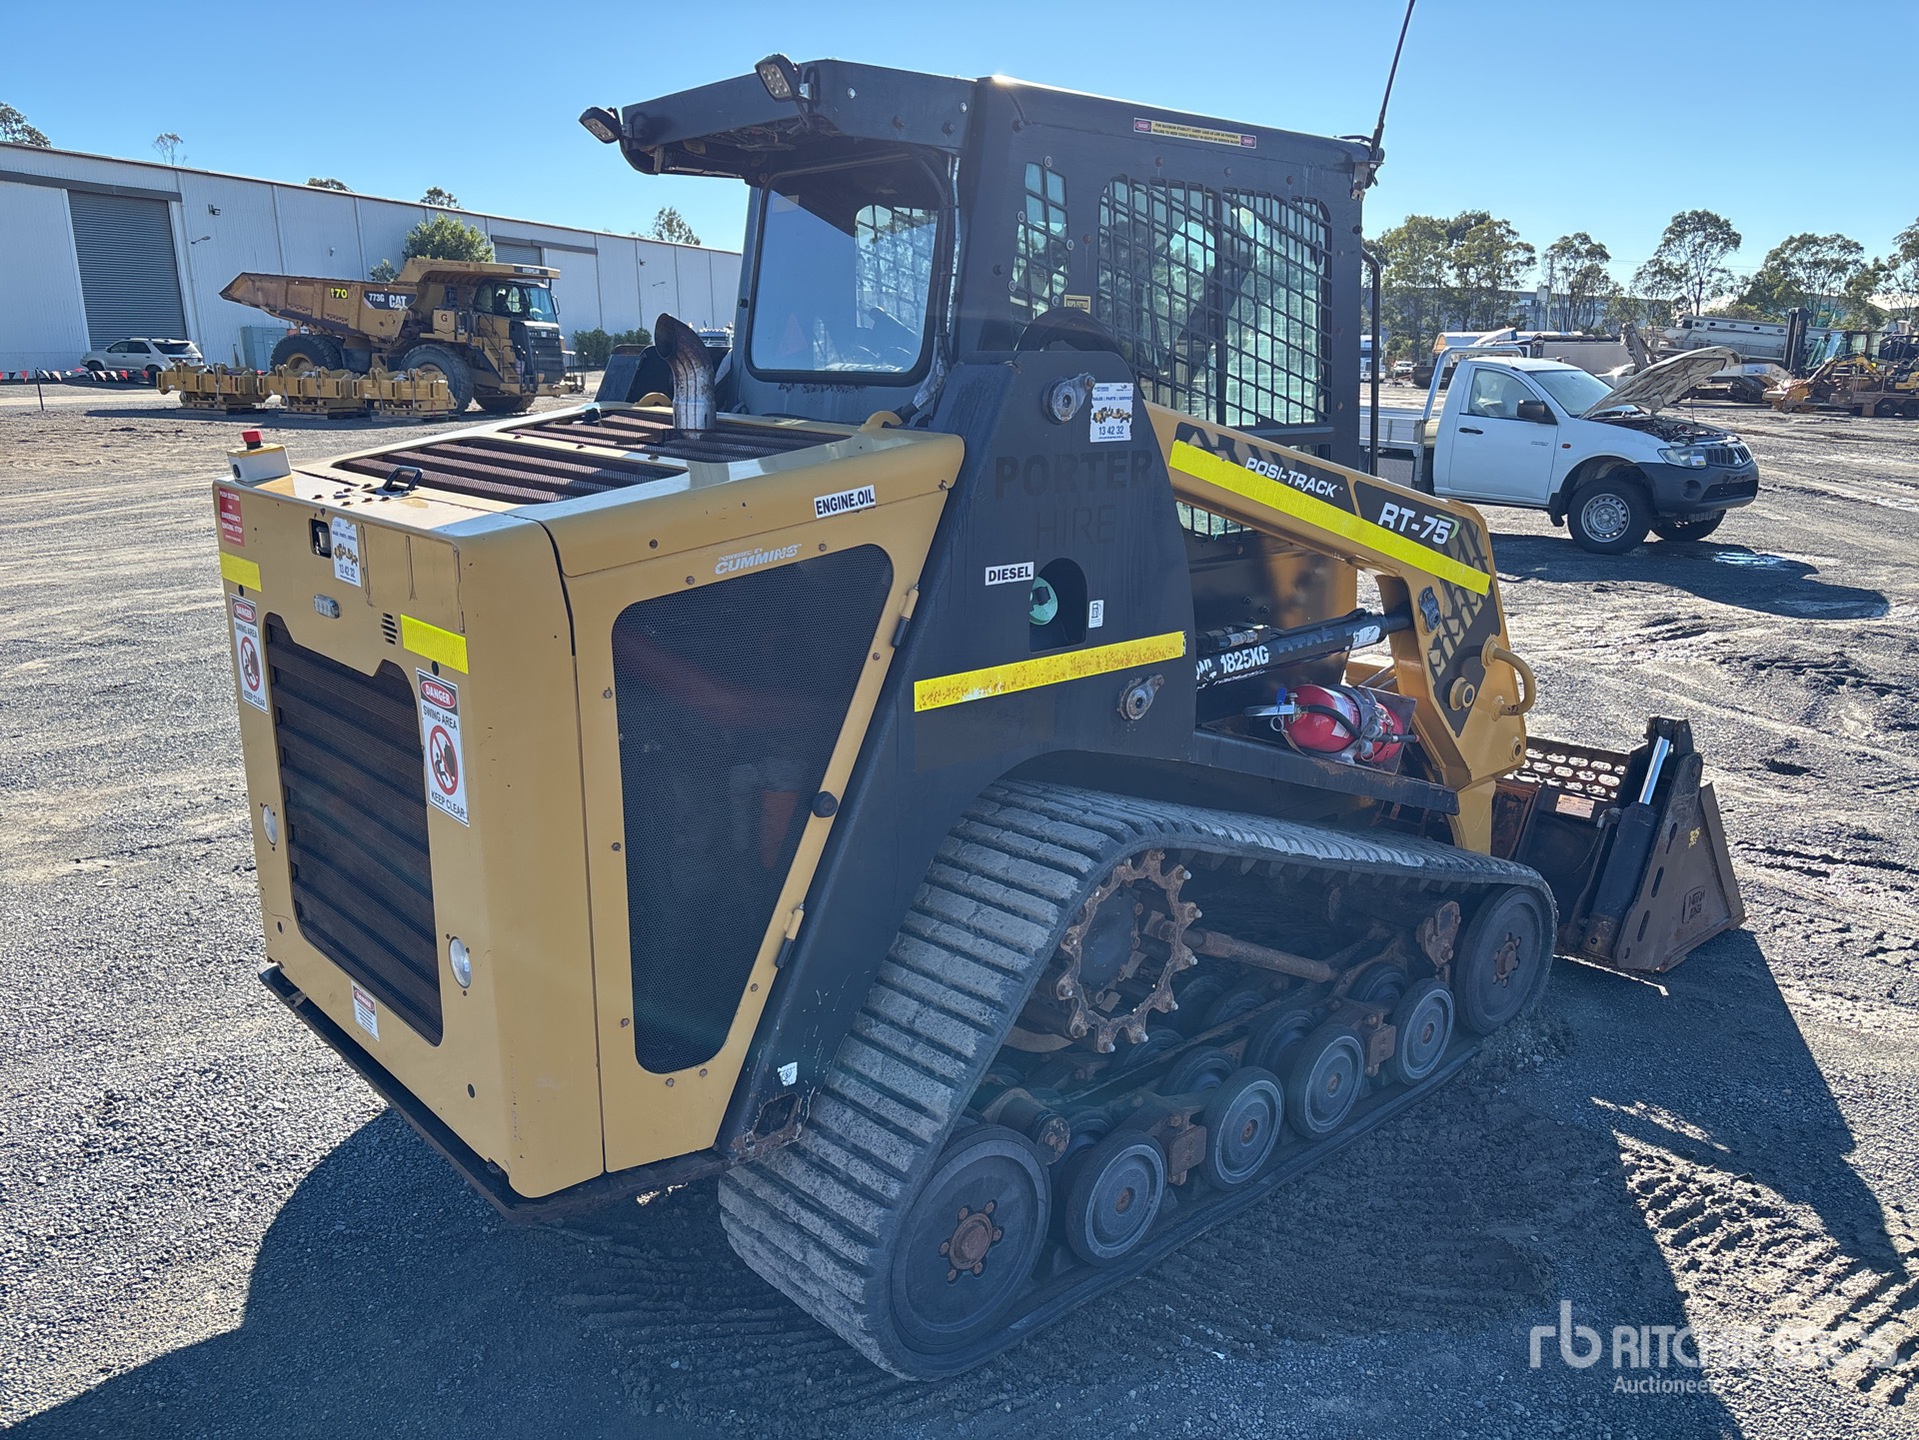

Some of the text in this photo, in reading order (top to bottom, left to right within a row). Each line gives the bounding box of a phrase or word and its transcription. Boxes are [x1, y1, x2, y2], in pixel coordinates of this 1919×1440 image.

[369, 293, 385, 302] 773G
[388, 295, 407, 308] CAT
[440, 314, 448, 322] G
[1098, 425, 1125, 435] 13 42 32
[995, 449, 1153, 499] PORTER
[1245, 457, 1338, 498] POSI-TRACK
[815, 489, 875, 515] ENGINE.OIL
[1035, 505, 1117, 550] HIRE
[1377, 502, 1452, 545] RT-75
[714, 544, 798, 575] CUMMINS
[988, 565, 1031, 583] DIESEL
[236, 604, 253, 620] DANGER
[235, 622, 258, 639] SWING AREA
[1219, 646, 1270, 675] 1825KG
[243, 689, 266, 708] KEEP CLEAR
[425, 684, 451, 706] DANGER
[422, 704, 458, 731] SWING AREA
[430, 790, 466, 819] KEEP CLEAR
